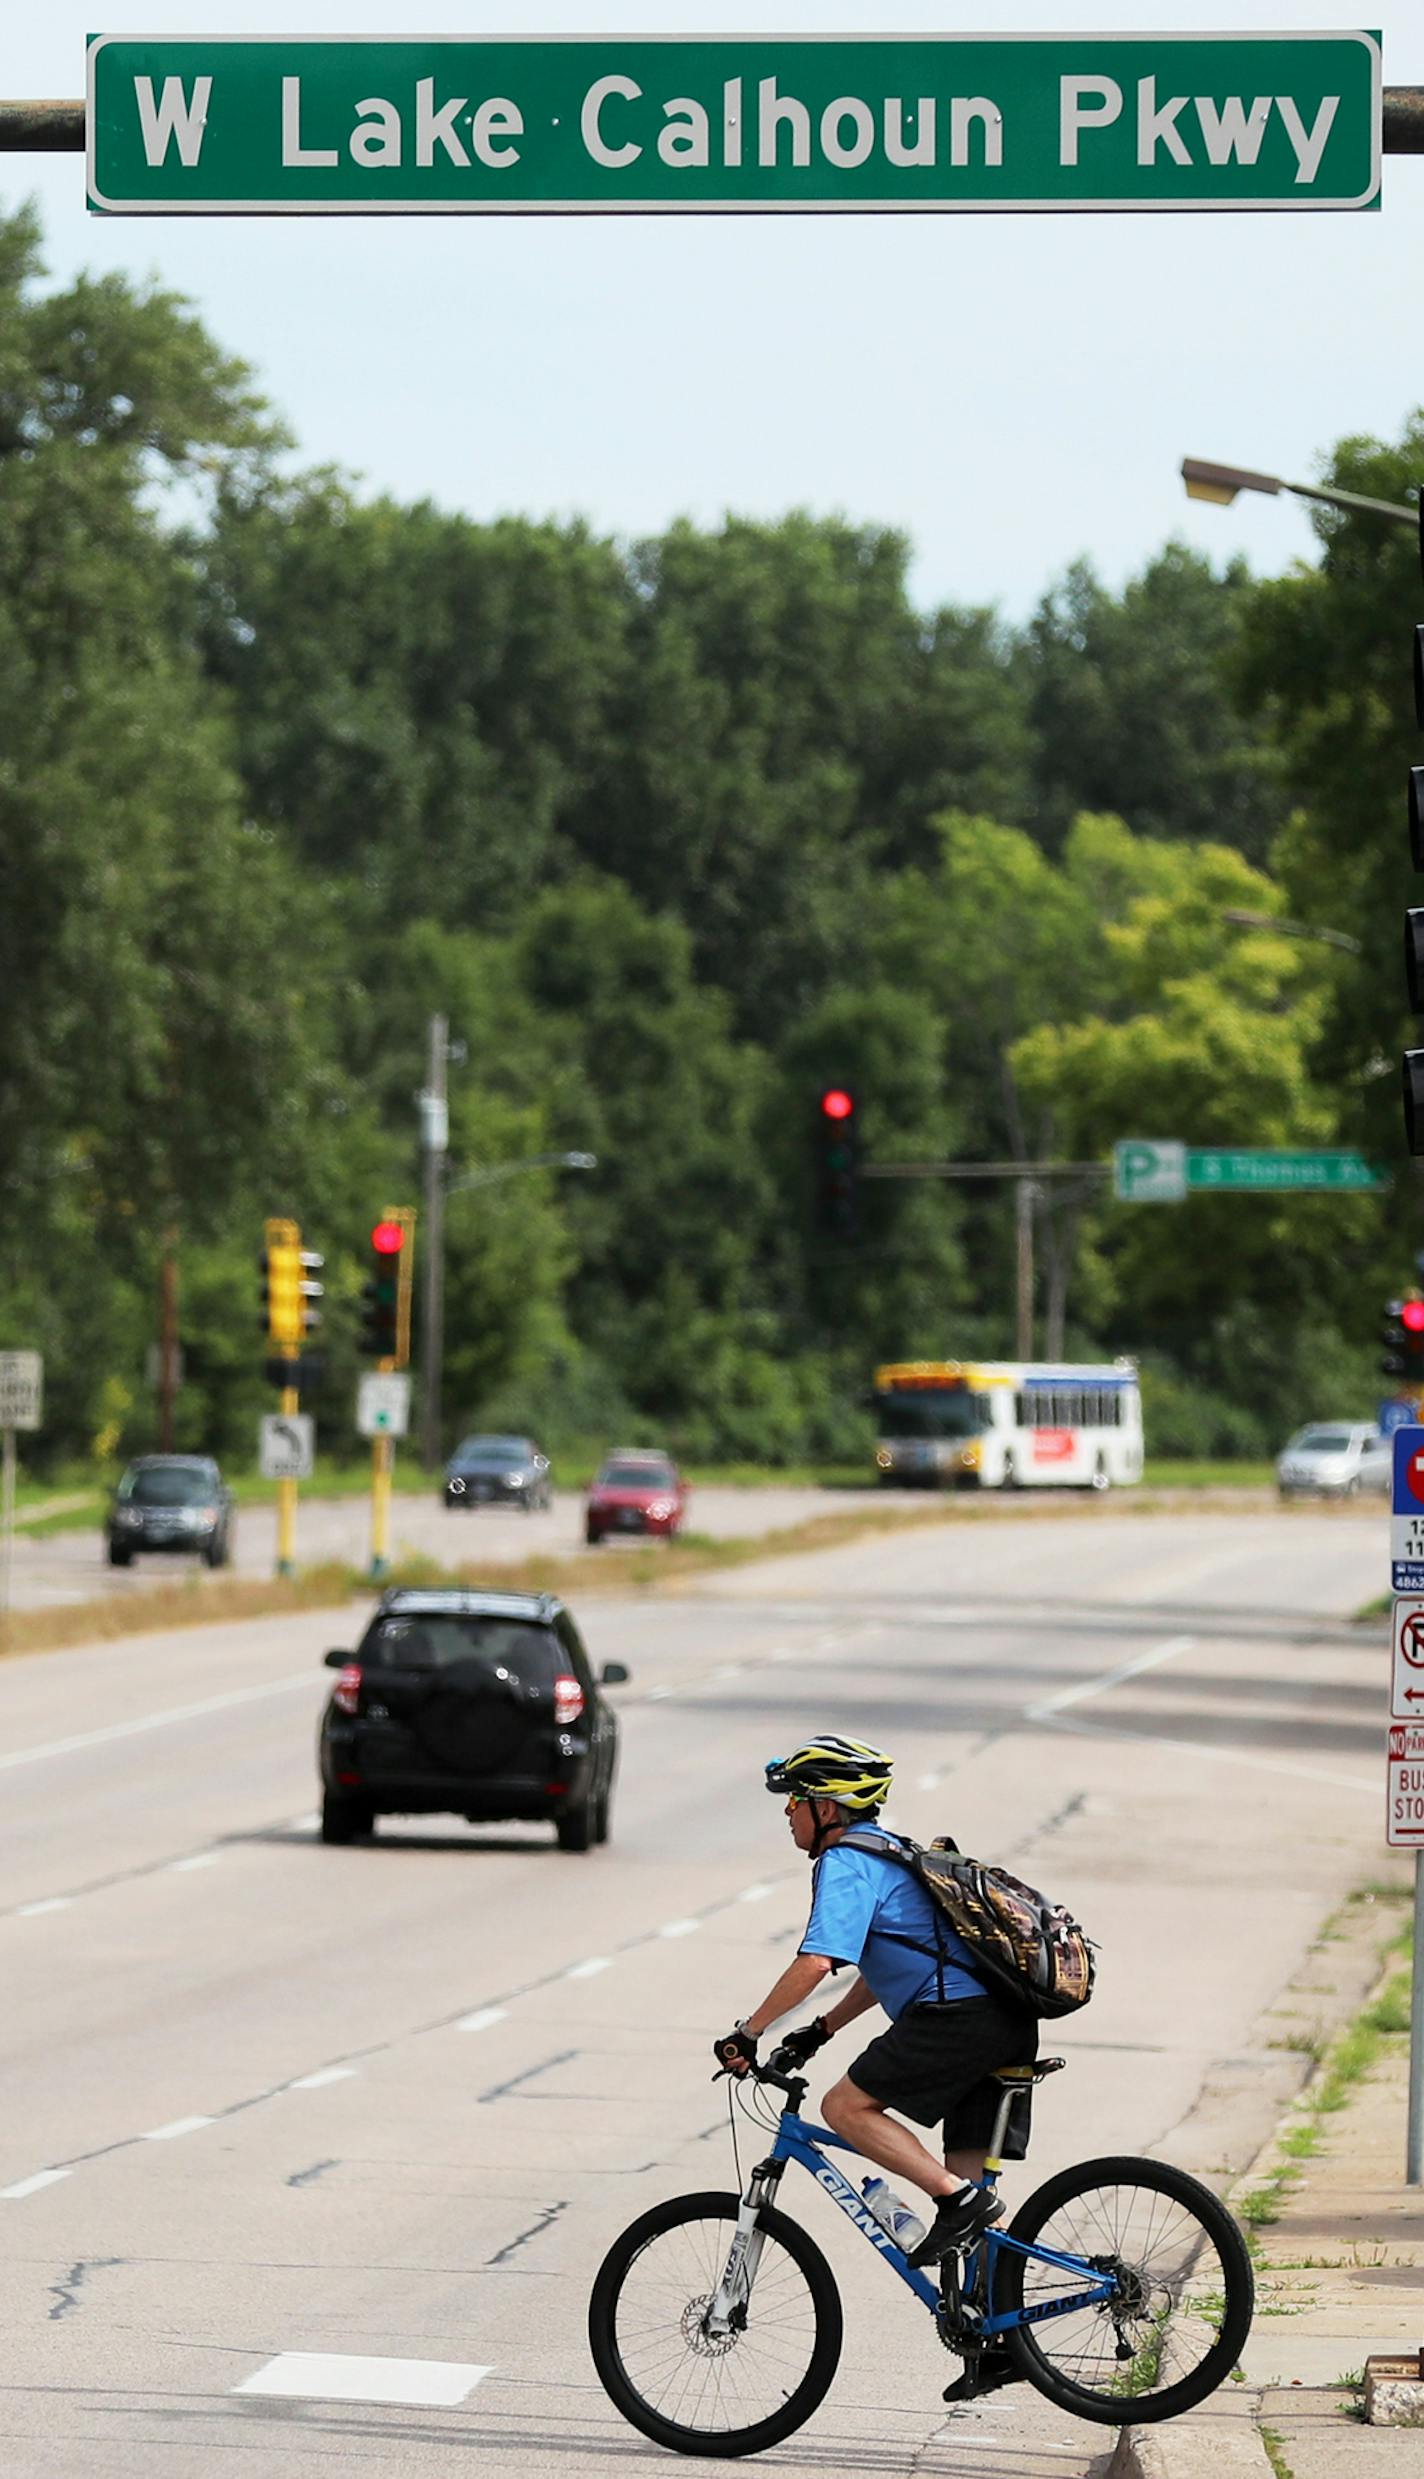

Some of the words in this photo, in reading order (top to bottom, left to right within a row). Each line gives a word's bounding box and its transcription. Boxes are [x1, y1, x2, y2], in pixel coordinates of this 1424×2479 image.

[133, 75, 213, 168] W
[281, 75, 525, 169] Lake
[580, 74, 1003, 169] Calhoun
[1059, 74, 1341, 184] Pkwy
[1390, 1732, 1405, 1755] NO
[815, 2168, 897, 2251] GIANT
[1017, 2291, 1089, 2322] GIANT
